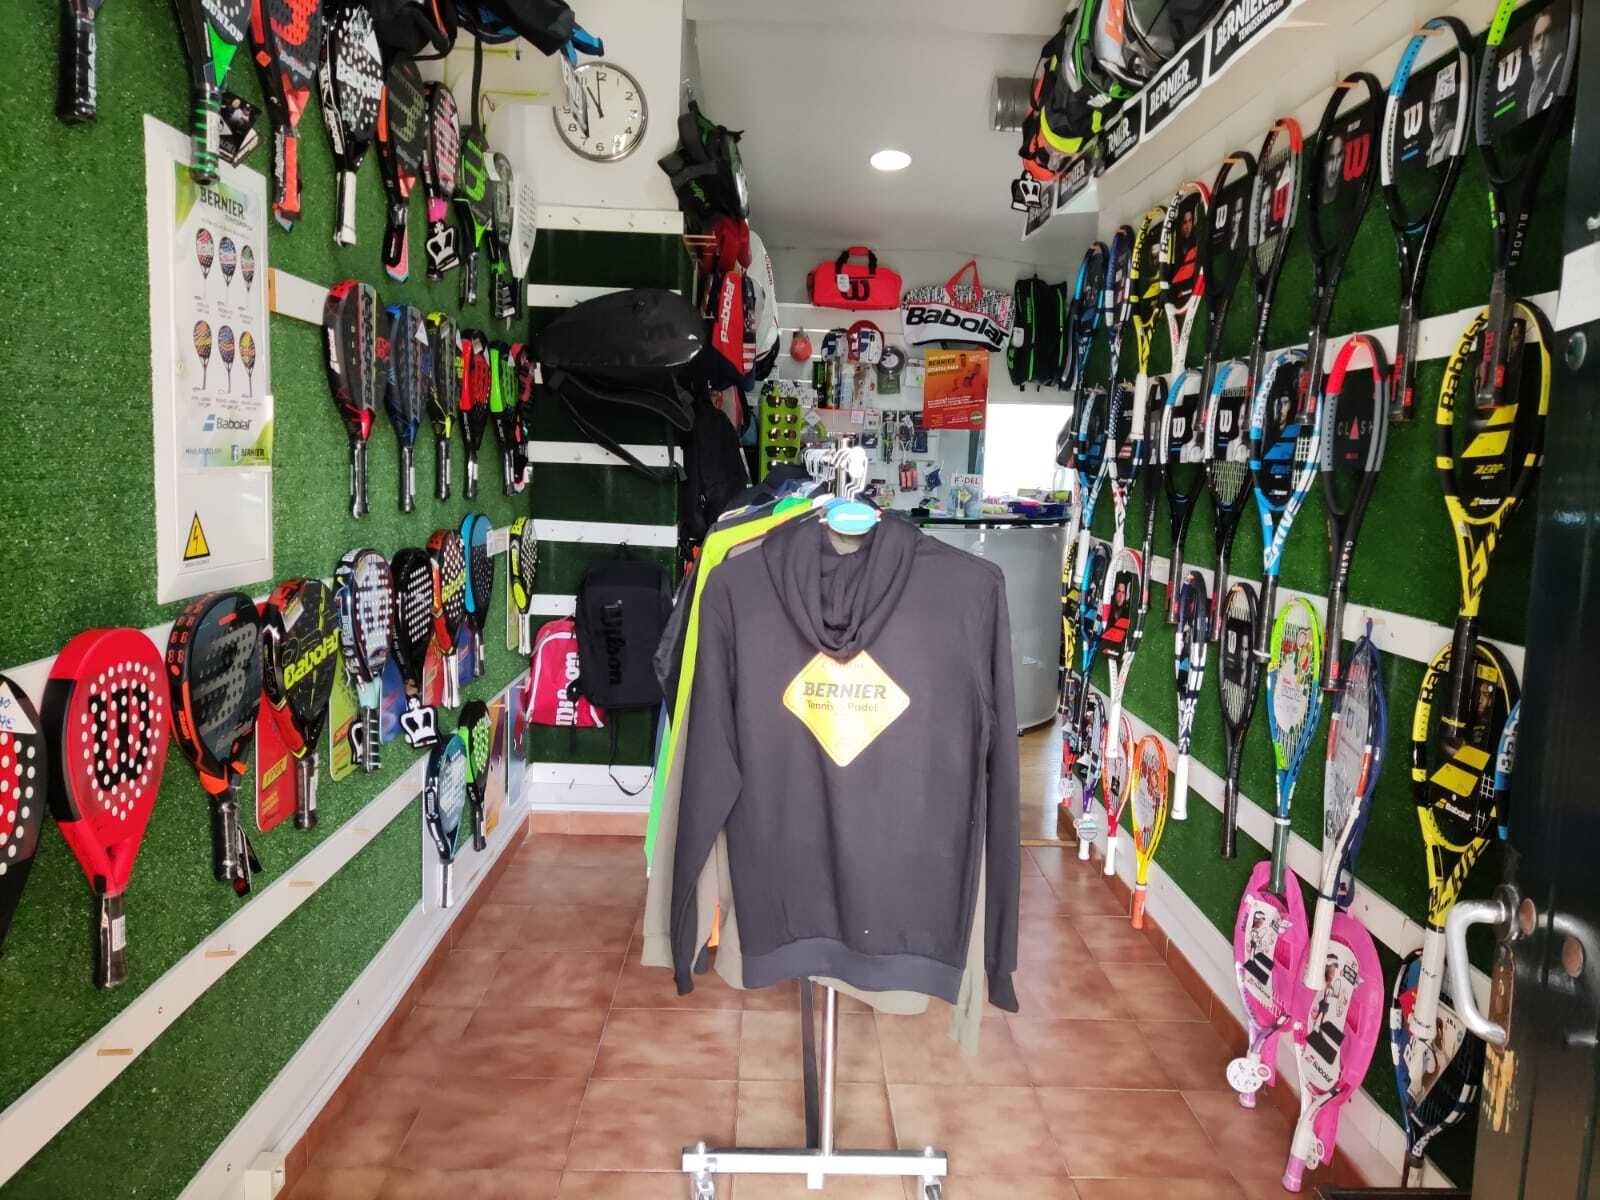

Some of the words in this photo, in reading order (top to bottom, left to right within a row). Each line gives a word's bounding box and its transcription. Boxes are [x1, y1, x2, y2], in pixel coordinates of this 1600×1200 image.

[1149, 59, 1190, 116] BERNIER
[595, 141, 605, 152] 6
[199, 186, 245, 220] BERNIER
[1511, 212, 1529, 258] BLADE
[906, 306, 1010, 346] Babolat
[1440, 312, 1489, 411] Babolat
[216, 414, 253, 431] Babolat
[284, 627, 340, 690] Babolat
[803, 681, 888, 700] BERNIER
[807, 700, 835, 712] Tennis
[847, 702, 878, 713] Padel
